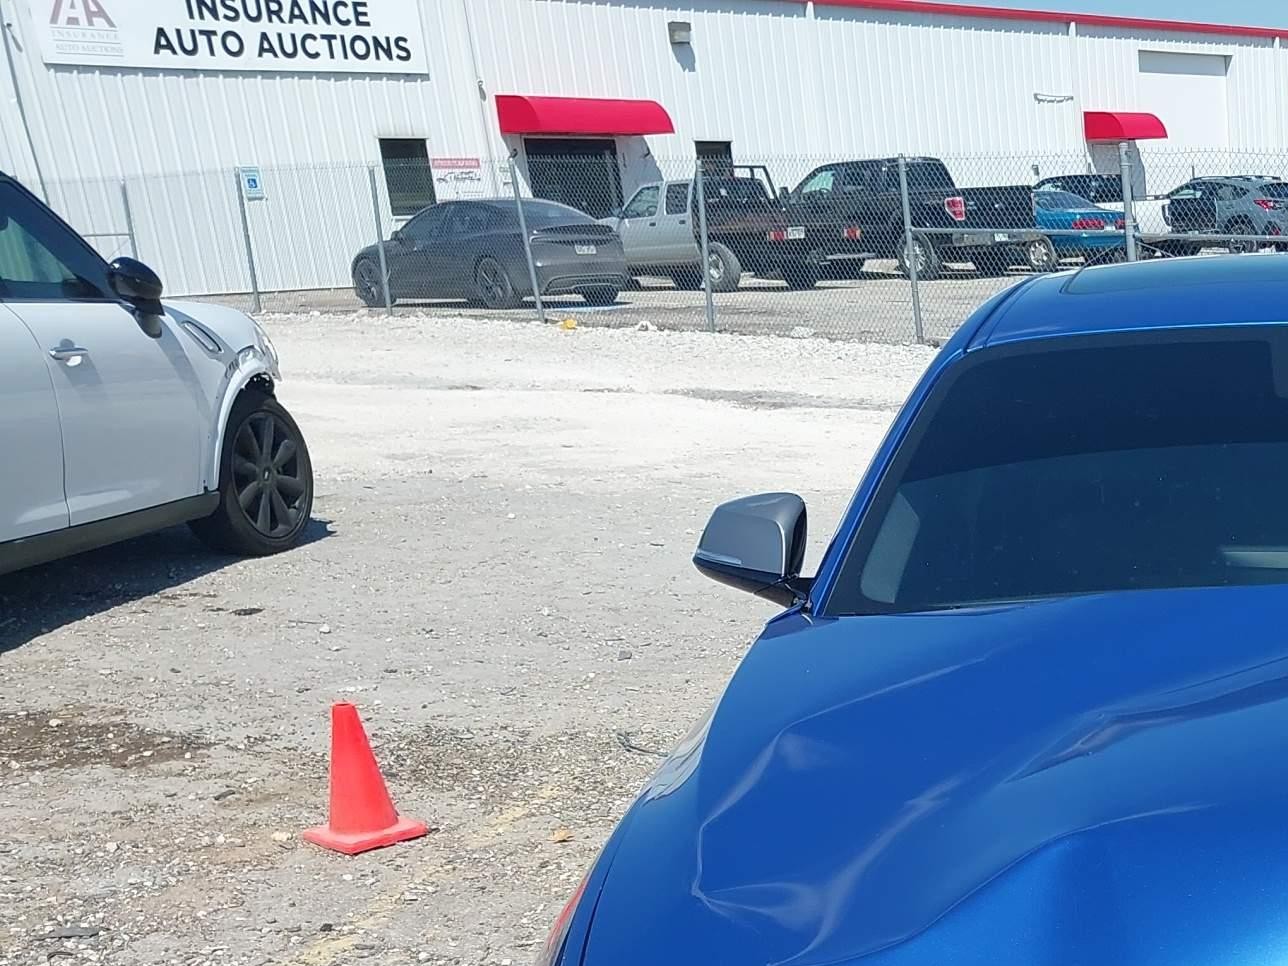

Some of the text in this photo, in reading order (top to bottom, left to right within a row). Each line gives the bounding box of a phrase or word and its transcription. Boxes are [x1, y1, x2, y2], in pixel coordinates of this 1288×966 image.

[185, 0, 371, 27] INSURANCE
[153, 27, 412, 62] AUTO AUCTIONS
